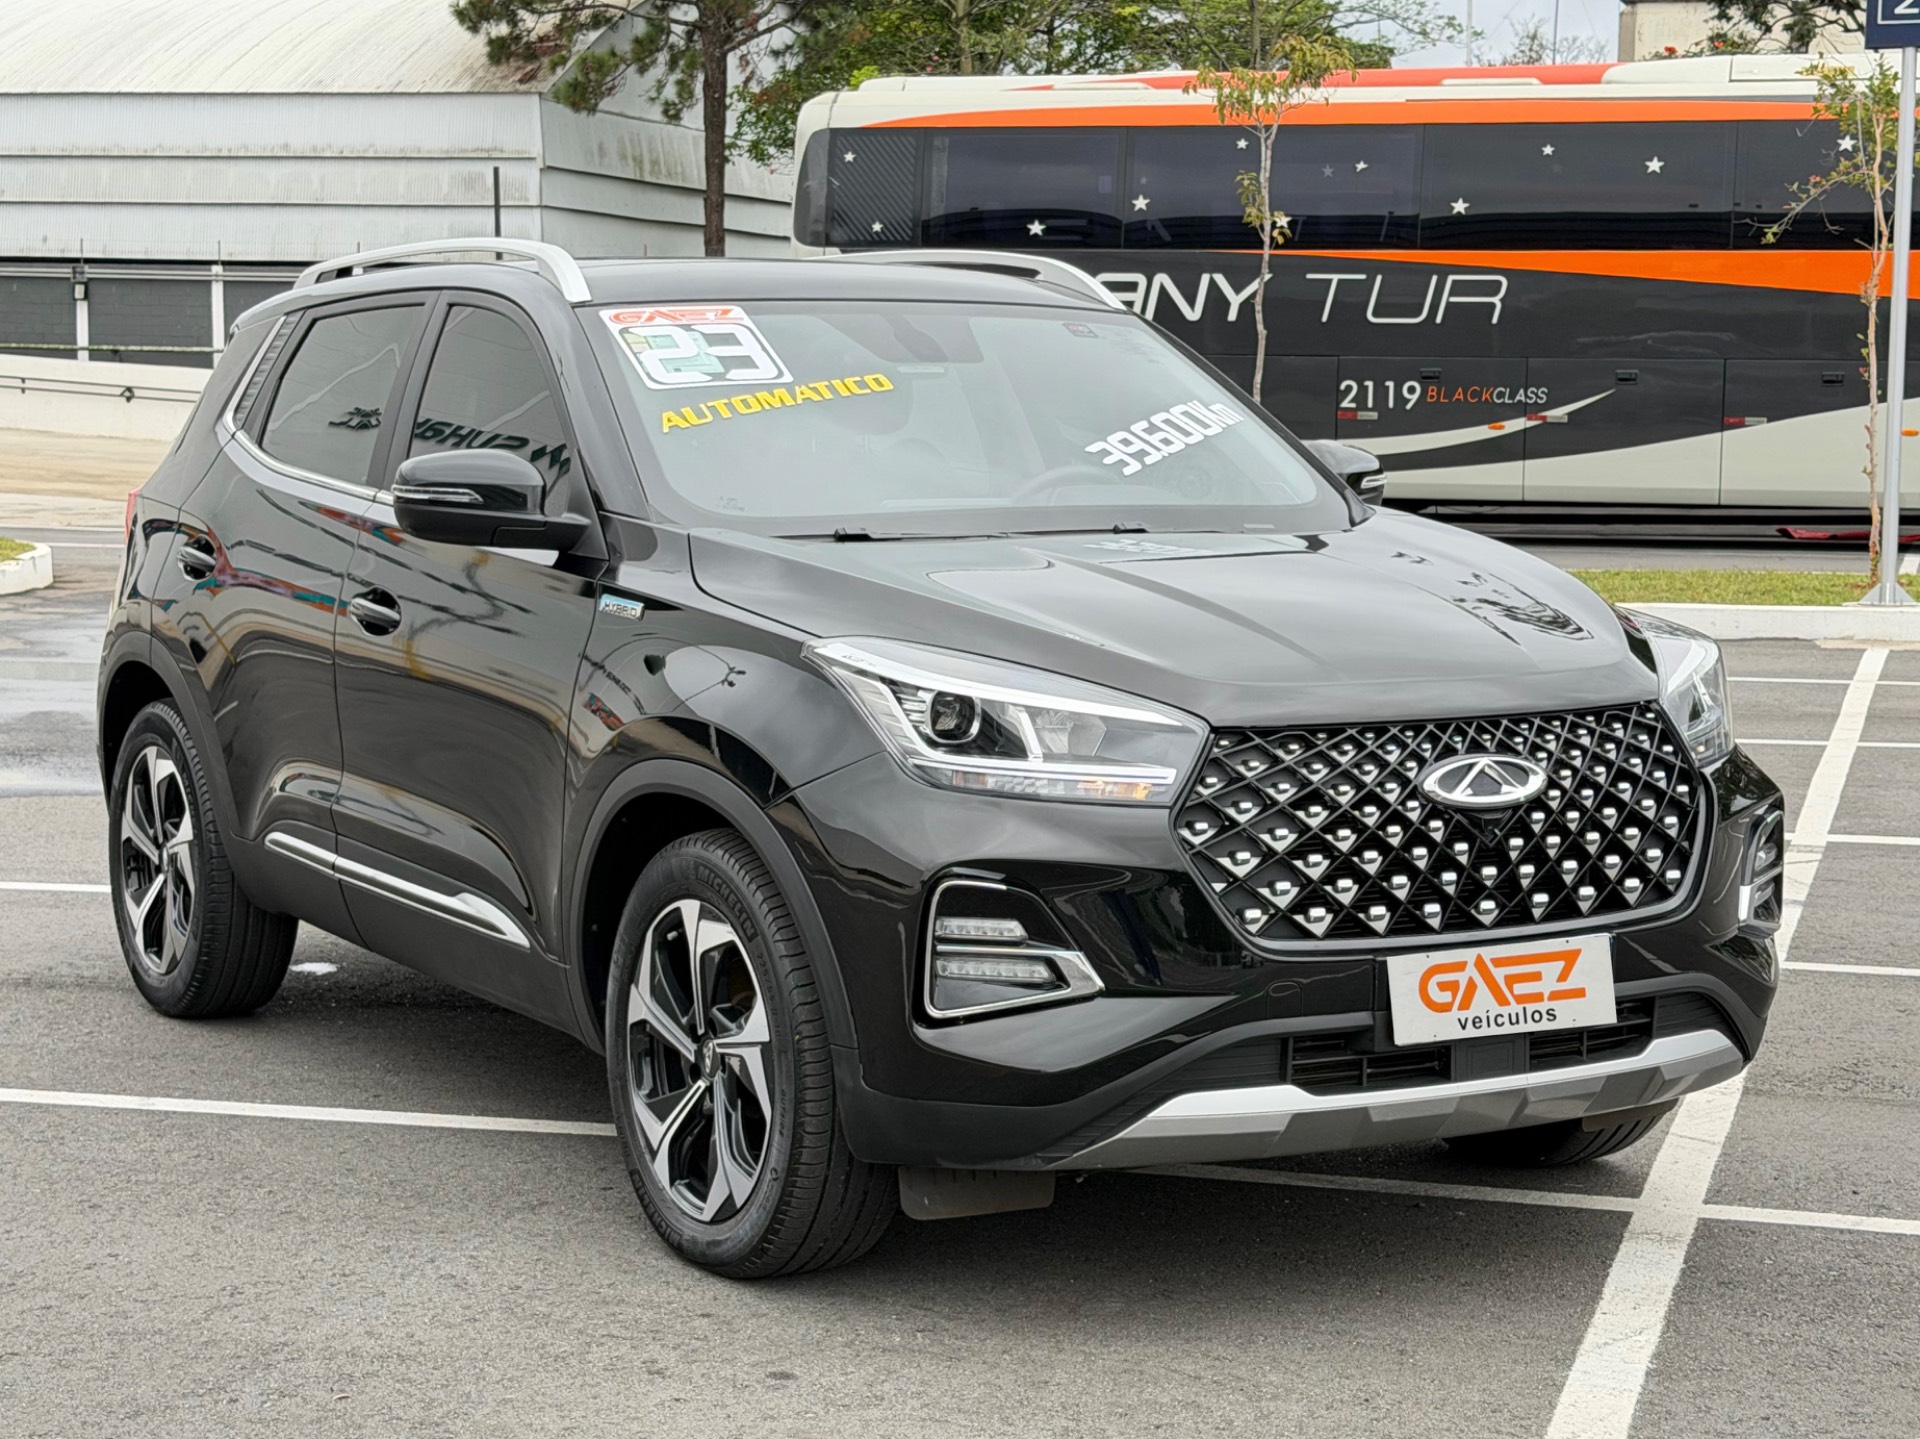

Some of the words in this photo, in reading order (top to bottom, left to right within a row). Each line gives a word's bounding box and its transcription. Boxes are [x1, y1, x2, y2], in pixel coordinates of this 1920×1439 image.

[1304, 272, 1508, 325] TUR
[627, 323, 779, 384] 23
[661, 373, 894, 434] AUTOMATICO
[1339, 379, 1422, 410] 2119
[698, 865, 758, 942] MICHELIN
[1418, 947, 1587, 1014] GAEZ
[1457, 1006, 1558, 1032] veículos
